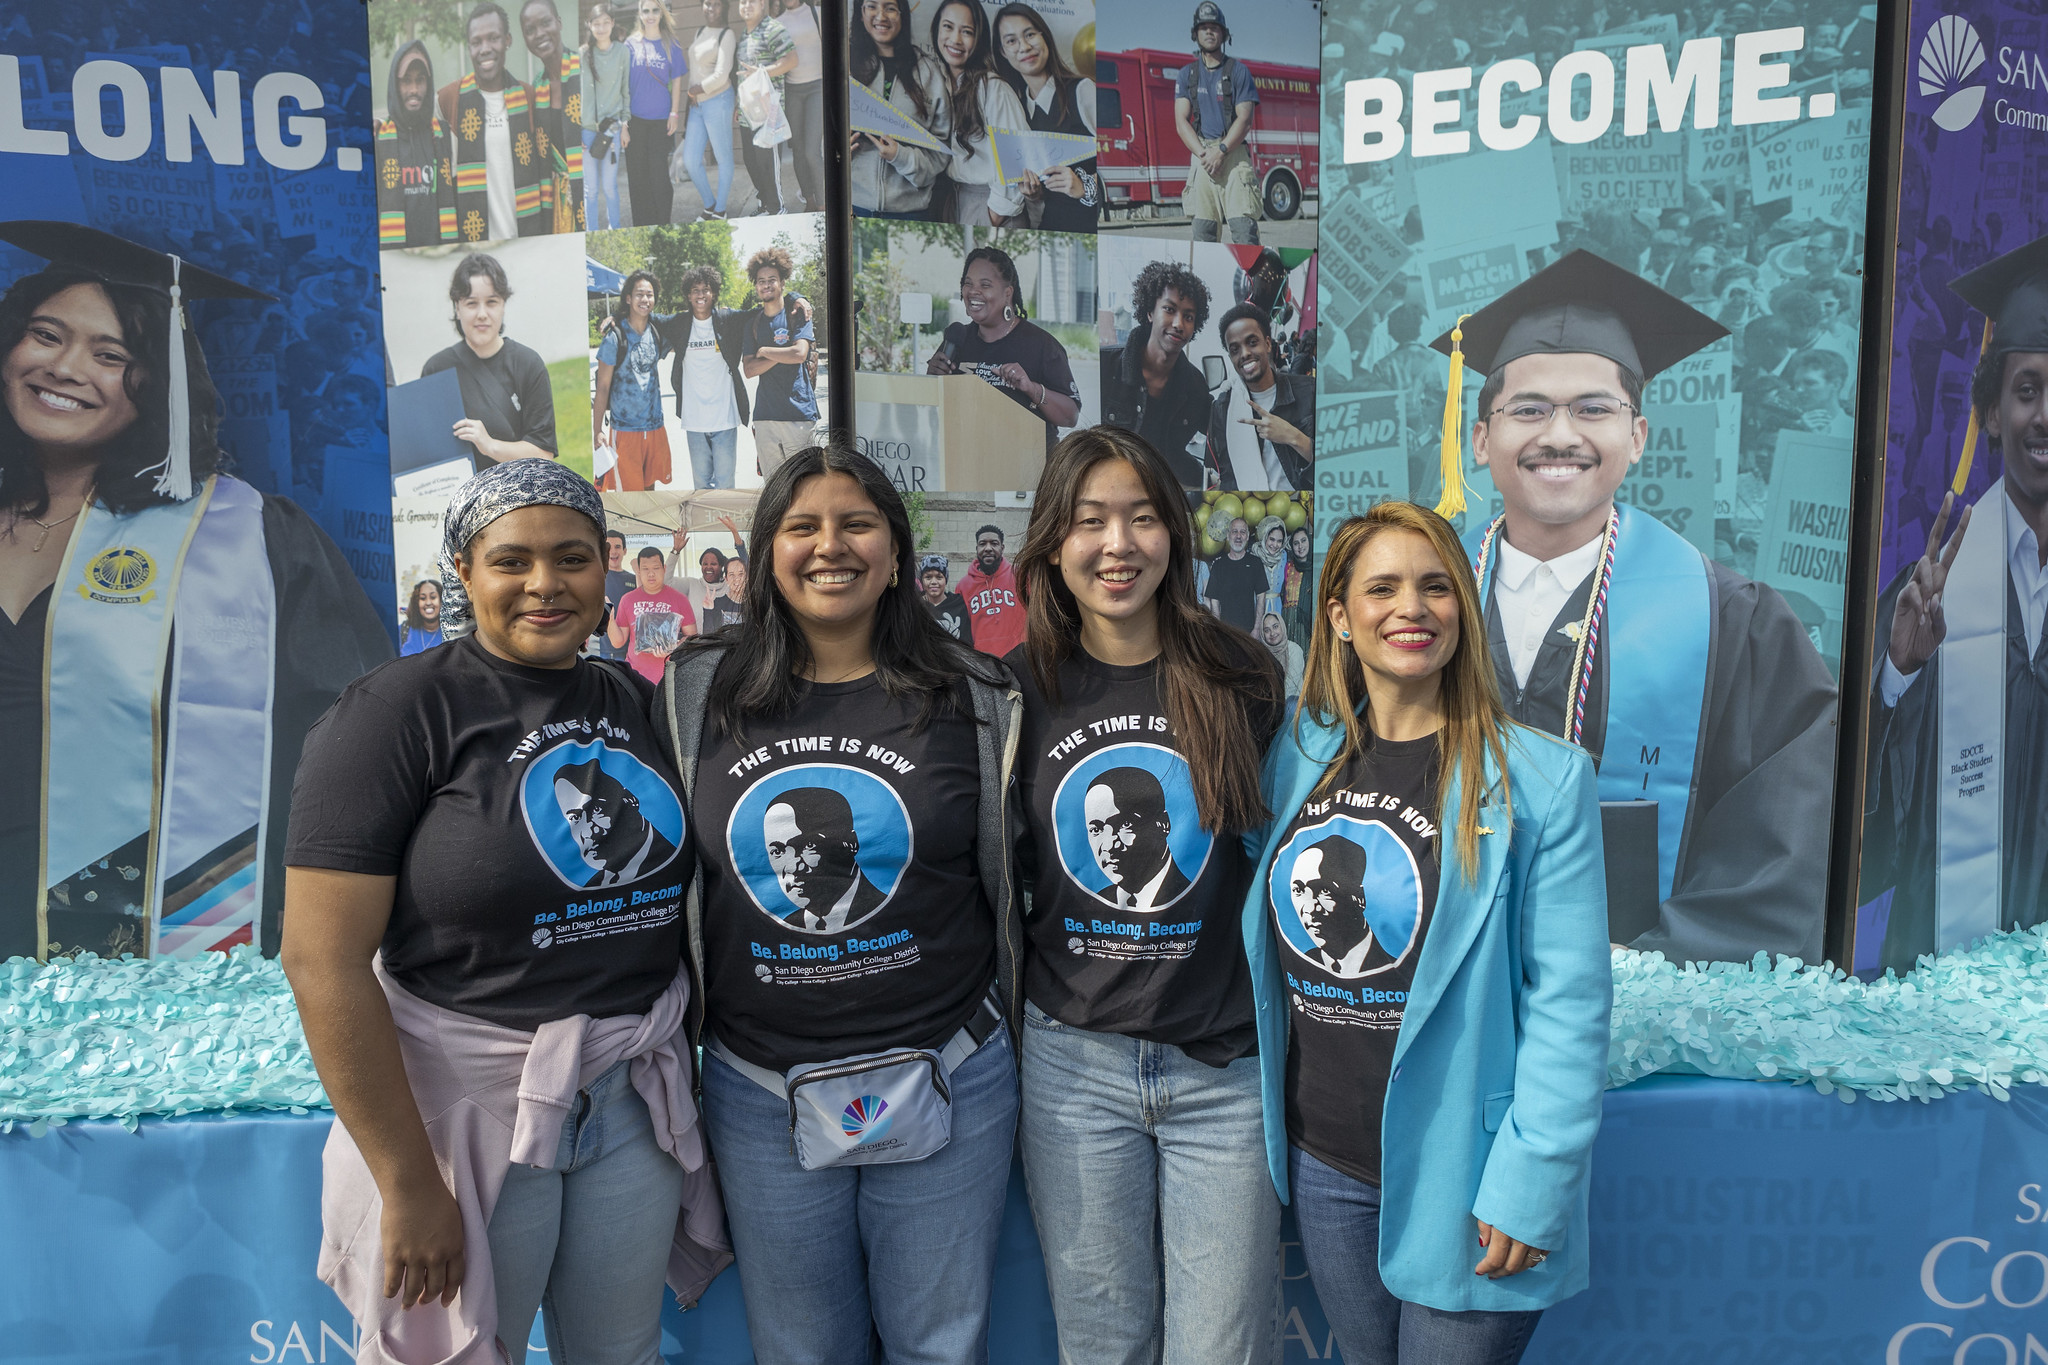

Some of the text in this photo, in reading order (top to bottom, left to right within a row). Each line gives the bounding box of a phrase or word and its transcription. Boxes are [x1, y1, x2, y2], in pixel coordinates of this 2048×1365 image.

[1255, 77, 1311, 93] OUNTY FIRE
[1343, 26, 1836, 164] BECOME.
[1994, 99, 2048, 132] Comm
[1702, 139, 1725, 152] TO
[1570, 154, 1682, 175] BENEVOLENT
[1829, 167, 1848, 179] TO
[1581, 181, 1676, 199] SOCIETY
[107, 194, 205, 220] SOCIETY
[1325, 218, 1389, 281] JOBS and
[1458, 252, 1488, 271] WE
[1439, 263, 1514, 297] MARCH
[1464, 286, 1496, 300] FOR
[1681, 359, 1714, 373] THE
[1645, 374, 1726, 405] EDOM
[1318, 402, 1361, 432] WE
[1315, 419, 1397, 457] EMAND
[1648, 426, 1688, 451] IAL
[1318, 470, 1389, 489] QUAL
[406, 509, 439, 528] Growing
[633, 601, 672, 609] LET'S GET
[507, 730, 542, 762] THE
[1048, 714, 1168, 761] THE TIME IS
[728, 736, 916, 778] THE TIME IS NOW
[1960, 743, 1985, 760] SDCCE
[1951, 755, 1994, 775] Black Student
[1960, 771, 1984, 785] Success
[1958, 784, 1986, 798] Program
[1300, 797, 1331, 819] HE
[1335, 789, 1380, 808] TIME
[1379, 794, 1401, 811] IS
[533, 911, 561, 925] Be.
[565, 897, 627, 920] Belong.
[555, 922, 570, 934] San
[572, 920, 595, 933] Diego
[596, 913, 640, 927] Community
[641, 906, 668, 919] College
[1064, 917, 1090, 933] Be.
[1091, 919, 1146, 941] Belong.
[751, 928, 914, 962] Be. Belong. Become.
[1087, 938, 1101, 947] San
[1101, 939, 1121, 951] Diego
[1121, 941, 1159, 952] Community
[1160, 940, 1187, 950] College
[775, 944, 920, 977] San Diego Community College District
[1286, 971, 1303, 993] Be.
[1302, 980, 1360, 1006] Belong.
[1313, 1003, 1335, 1014] Diego
[1335, 1005, 1378, 1021] Community
[1379, 1010, 1405, 1020] Colleg
[846, 1138, 898, 1154] SAN DIEGO
[2015, 1183, 2048, 1223] S
[1747, 1233, 1888, 1280] DEPT.
